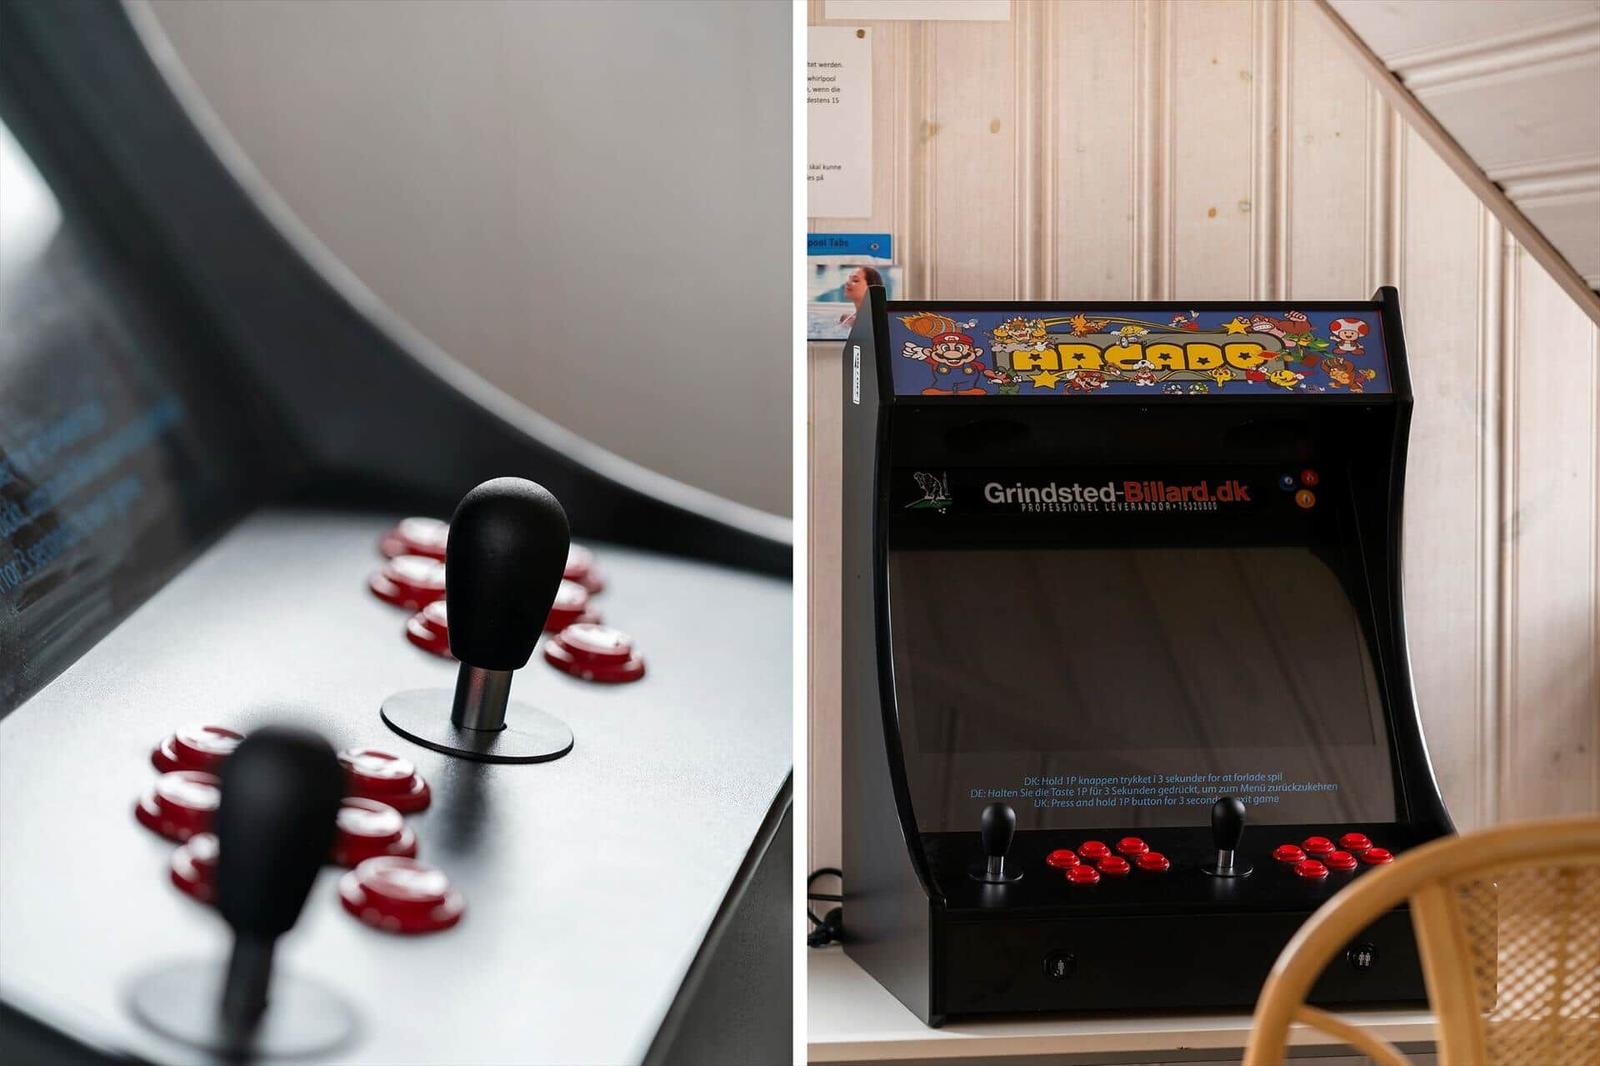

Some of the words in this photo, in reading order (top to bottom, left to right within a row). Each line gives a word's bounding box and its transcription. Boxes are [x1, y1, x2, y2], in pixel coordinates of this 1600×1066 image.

[831, 238, 849, 248] Tabs
[984, 480, 1251, 503] Grindsted-Billard.dk
[1021, 503, 1099, 512] PROFESSIONEL
[1024, 776, 1040, 786] DK:
[1041, 776, 1063, 785] Hold
[1067, 776, 1077, 785] 1P
[1079, 775, 1118, 787] knappen
[1120, 775, 1152, 786] trykket
[1158, 774, 1164, 784] 3
[1166, 774, 1206, 783] sekunder
[1208, 773, 1220, 782] for
[1223, 774, 1232, 782] at
[1233, 772, 1265, 782] forlade
[1267, 772, 1283, 783] spil
[970, 789, 986, 798] DE:
[988, 788, 1018, 798] Halten
[1020, 788, 1034, 797] Sie
[1035, 787, 1049, 797] die
[1052, 788, 1074, 797] Taste
[1077, 787, 1087, 796] 1P
[1089, 786, 1102, 797] für
[1104, 787, 1110, 796] 3
[1112, 786, 1156, 795] Sekunden
[1202, 786, 1217, 794] um
[1240, 783, 1265, 793] Menü
[1267, 782, 1338, 792] zurückzukehren
[1034, 799, 1049, 808] UK:
[1051, 798, 1074, 807] Press
[1076, 798, 1094, 807] and
[1096, 797, 1116, 807] hold
[1119, 797, 1130, 806] 1P
[1131, 797, 1162, 806] button
[1164, 796, 1177, 806] for
[1179, 796, 1185, 805] 3
[1253, 796, 1280, 806] game
